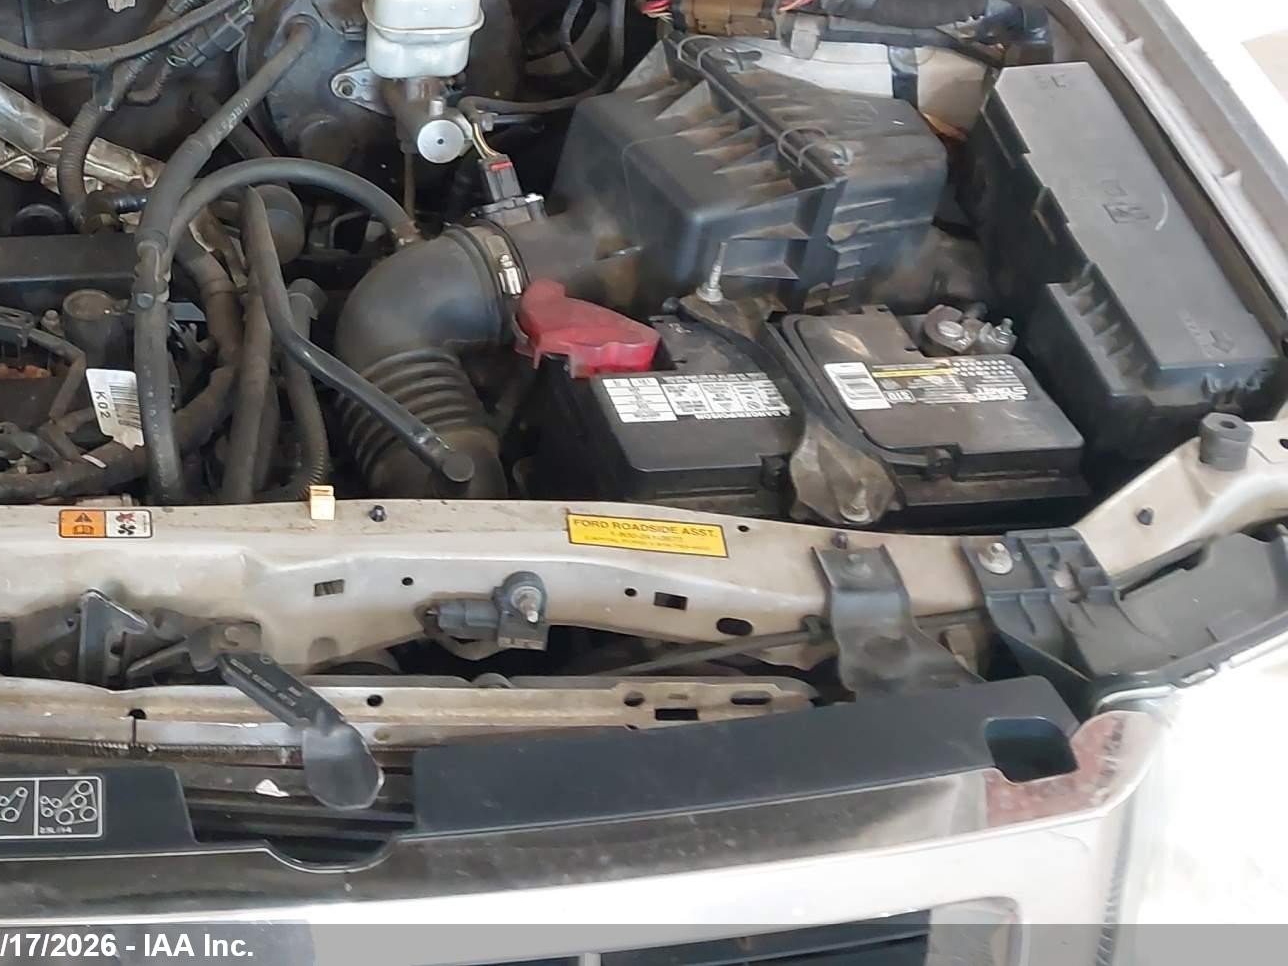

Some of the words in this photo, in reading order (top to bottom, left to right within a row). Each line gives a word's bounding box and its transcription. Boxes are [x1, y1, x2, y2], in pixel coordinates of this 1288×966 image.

[94, 390, 111, 419] K02
[573, 519, 609, 529] FORD
[611, 520, 679, 534] ROADSIDE
